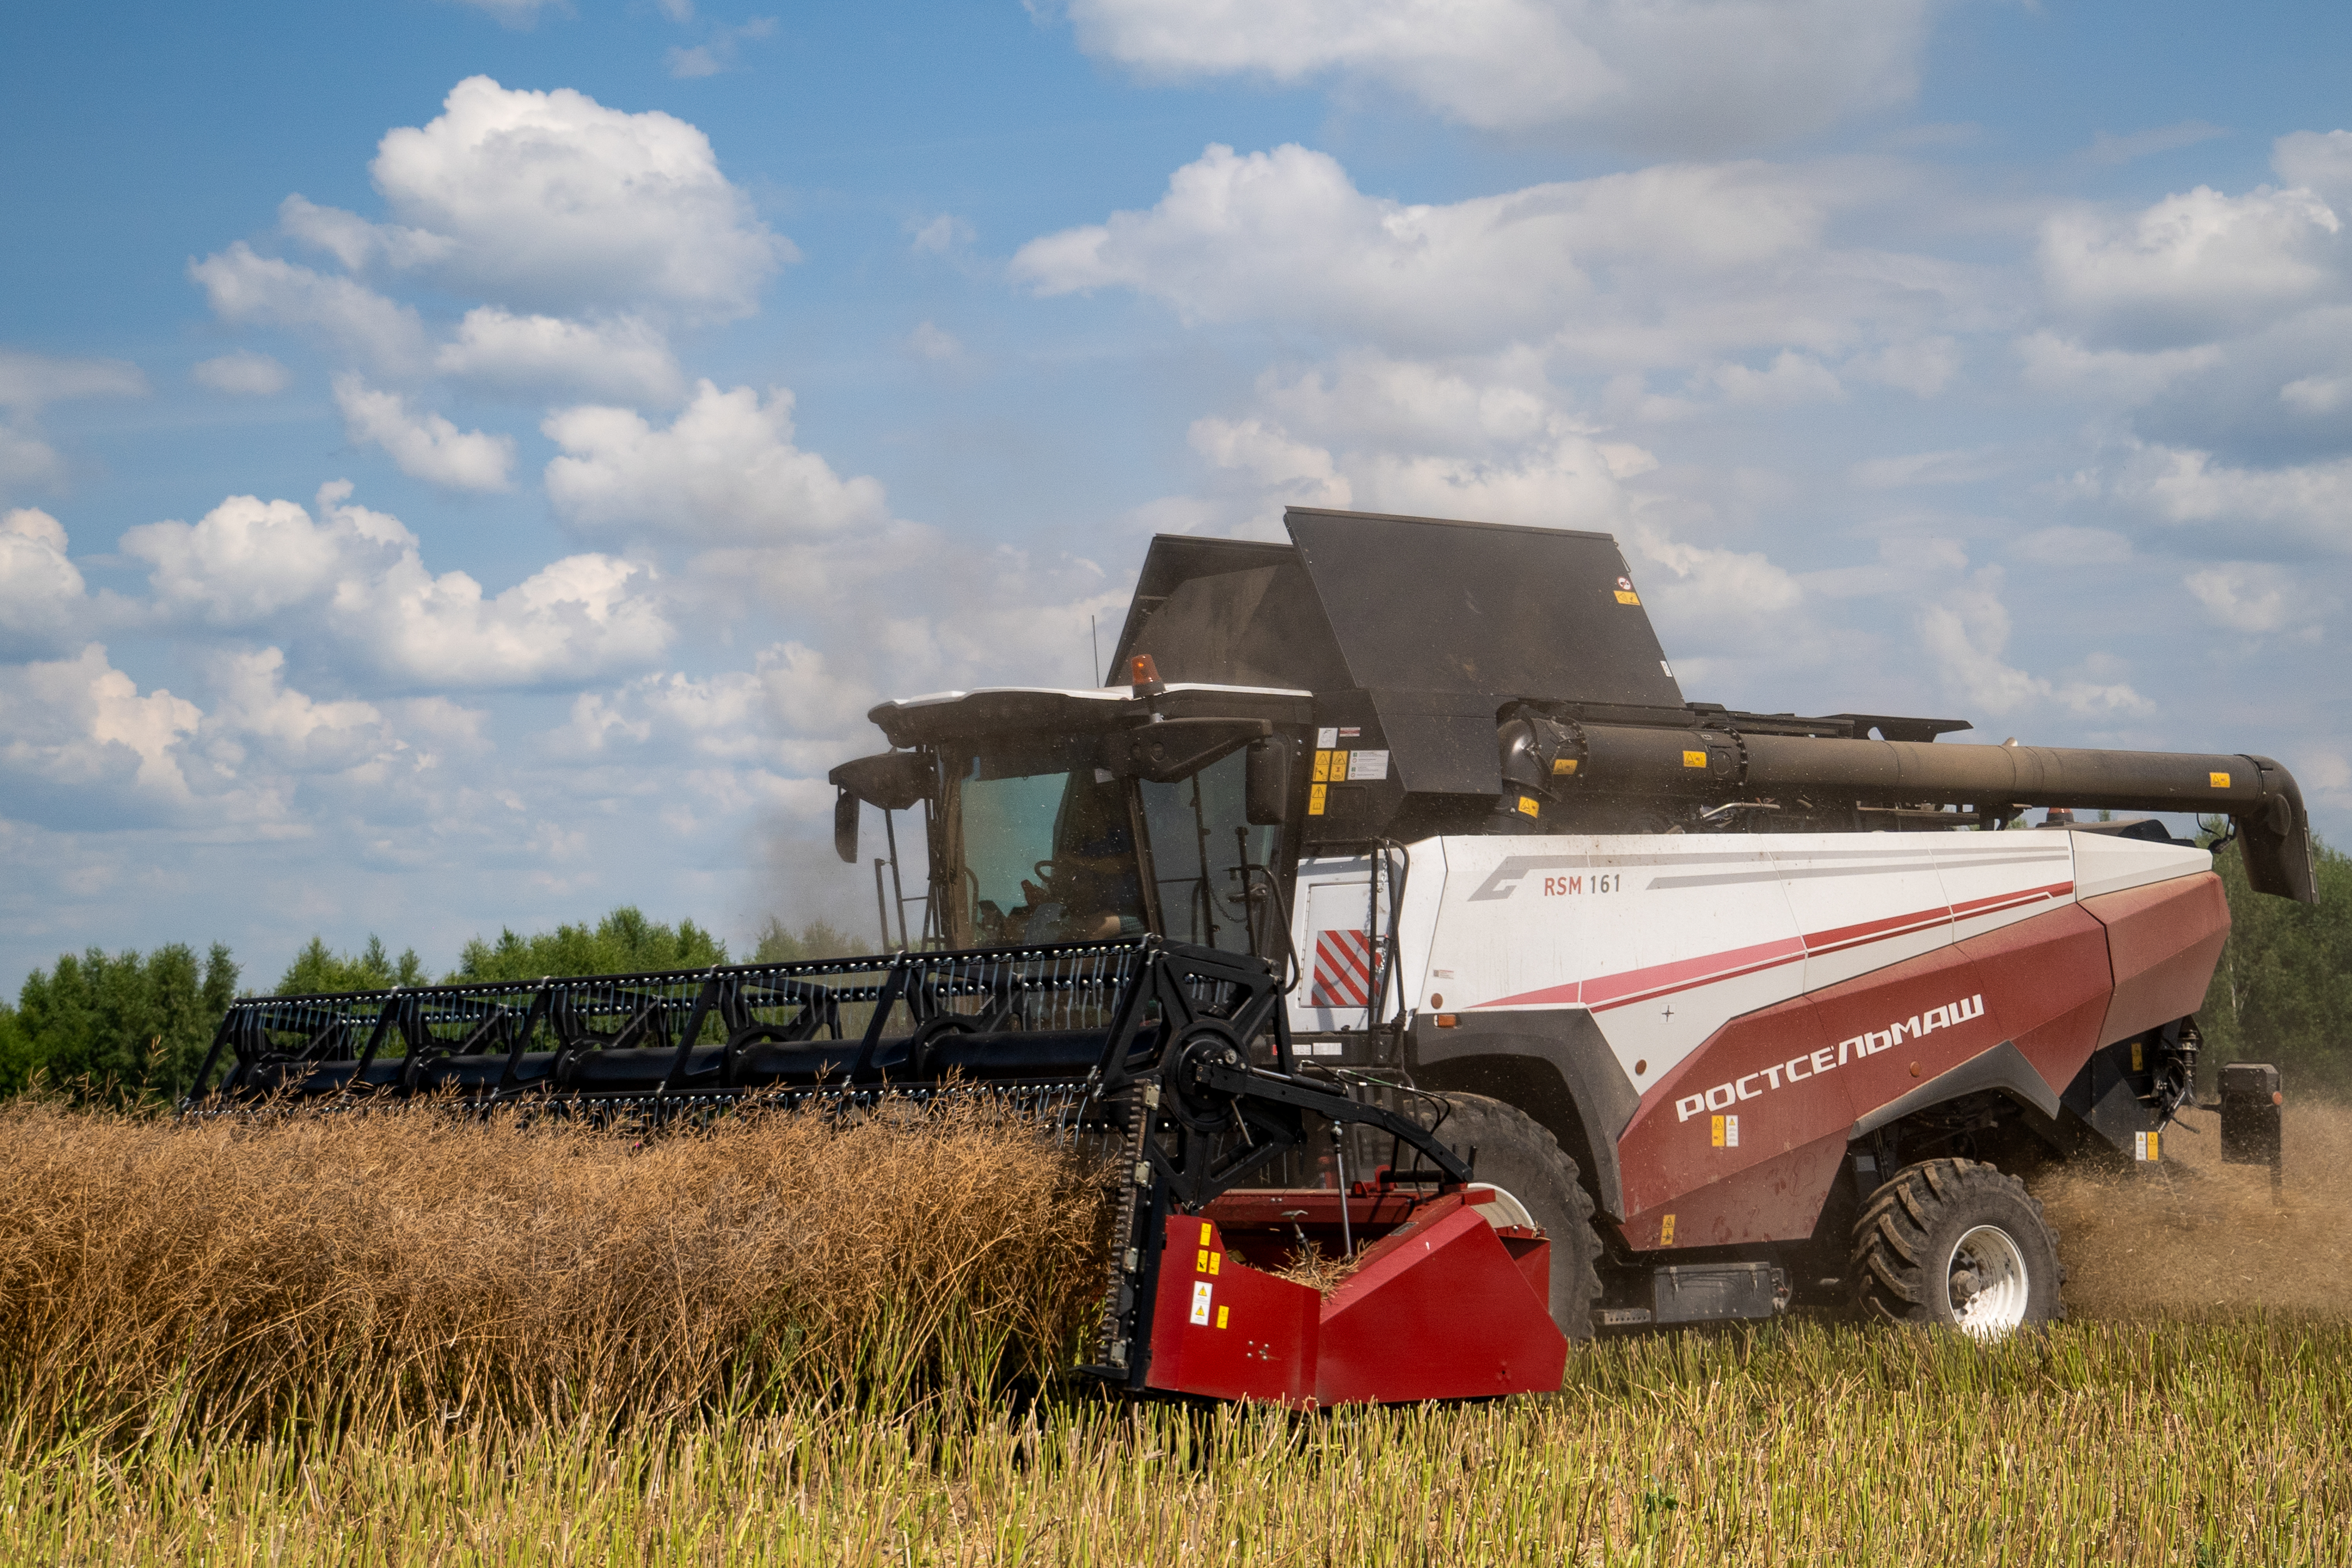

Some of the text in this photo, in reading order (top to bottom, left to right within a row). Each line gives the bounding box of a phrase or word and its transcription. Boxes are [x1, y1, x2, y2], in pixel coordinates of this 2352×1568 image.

[1544, 874, 1620, 896] RSM 161
[1675, 994, 1984, 1122] РОСТСЕЛЬМАШ
